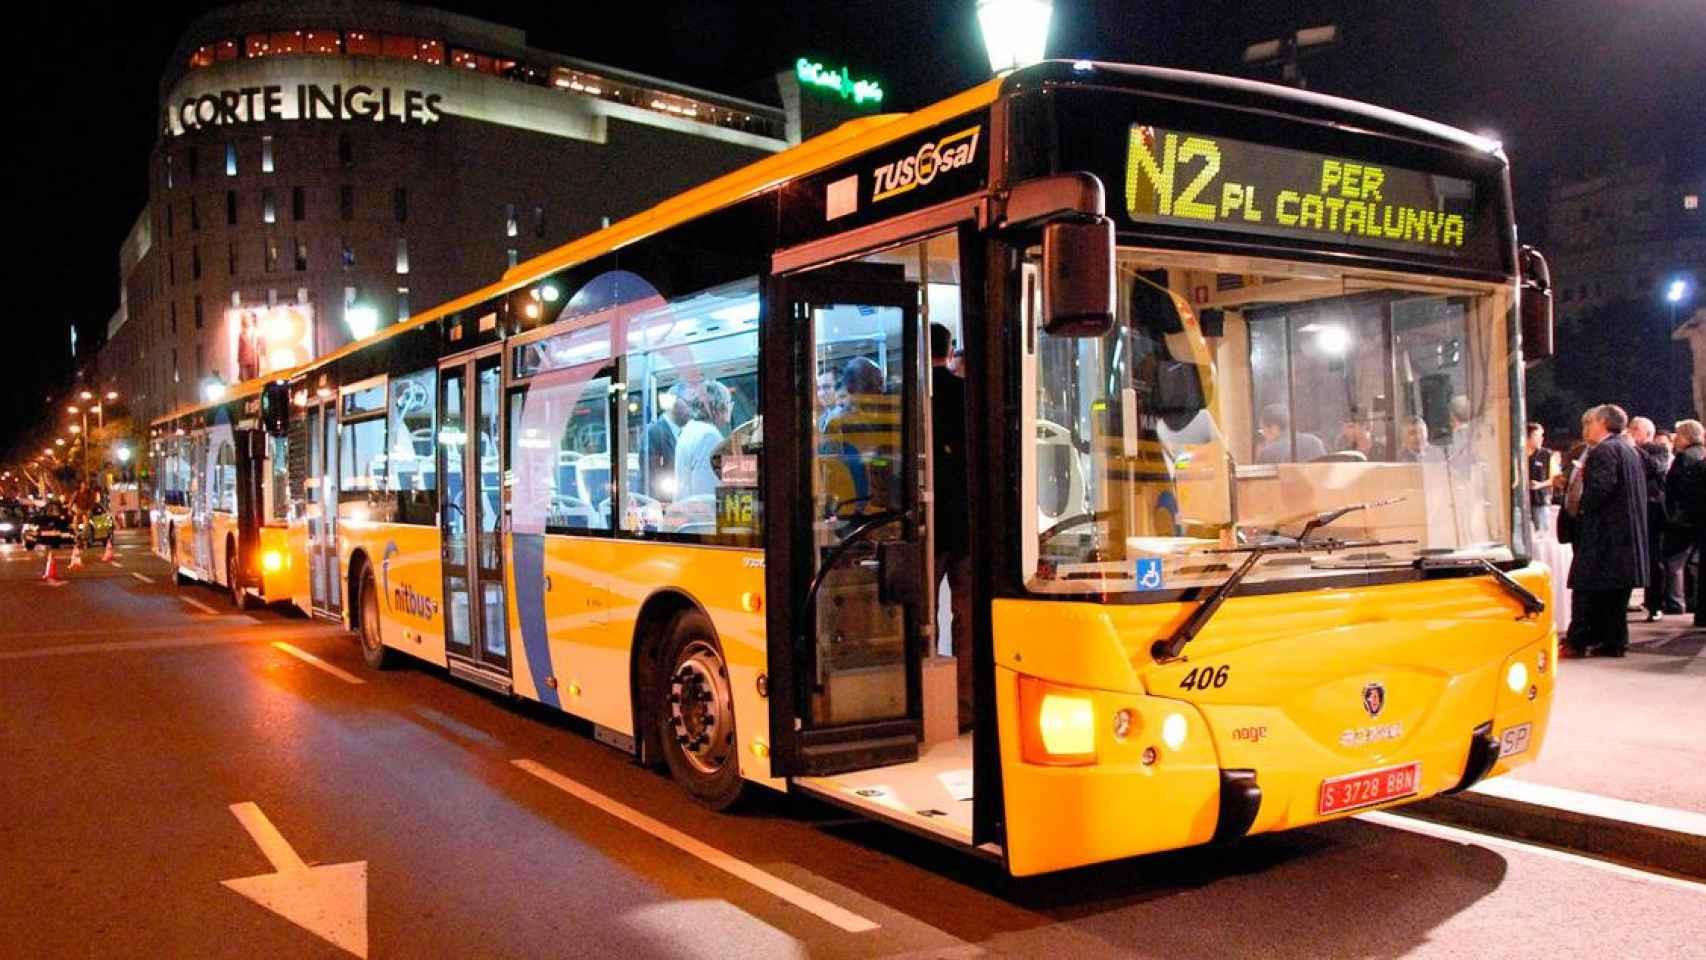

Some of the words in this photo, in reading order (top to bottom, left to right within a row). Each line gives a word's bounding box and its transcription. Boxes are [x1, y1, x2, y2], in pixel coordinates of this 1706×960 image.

[179, 85, 284, 130] CORTE
[297, 84, 442, 123] INGLES
[1126, 126, 1221, 221] N2
[1321, 159, 1385, 201] PER
[1220, 182, 1262, 221] PL
[1275, 189, 1465, 247] CATALUNYA
[1179, 664, 1230, 691] 406
[1503, 726, 1528, 753] SP
[1325, 786, 1336, 808] S
[1343, 777, 1380, 803] 3728
[1386, 768, 1415, 793] BBN
